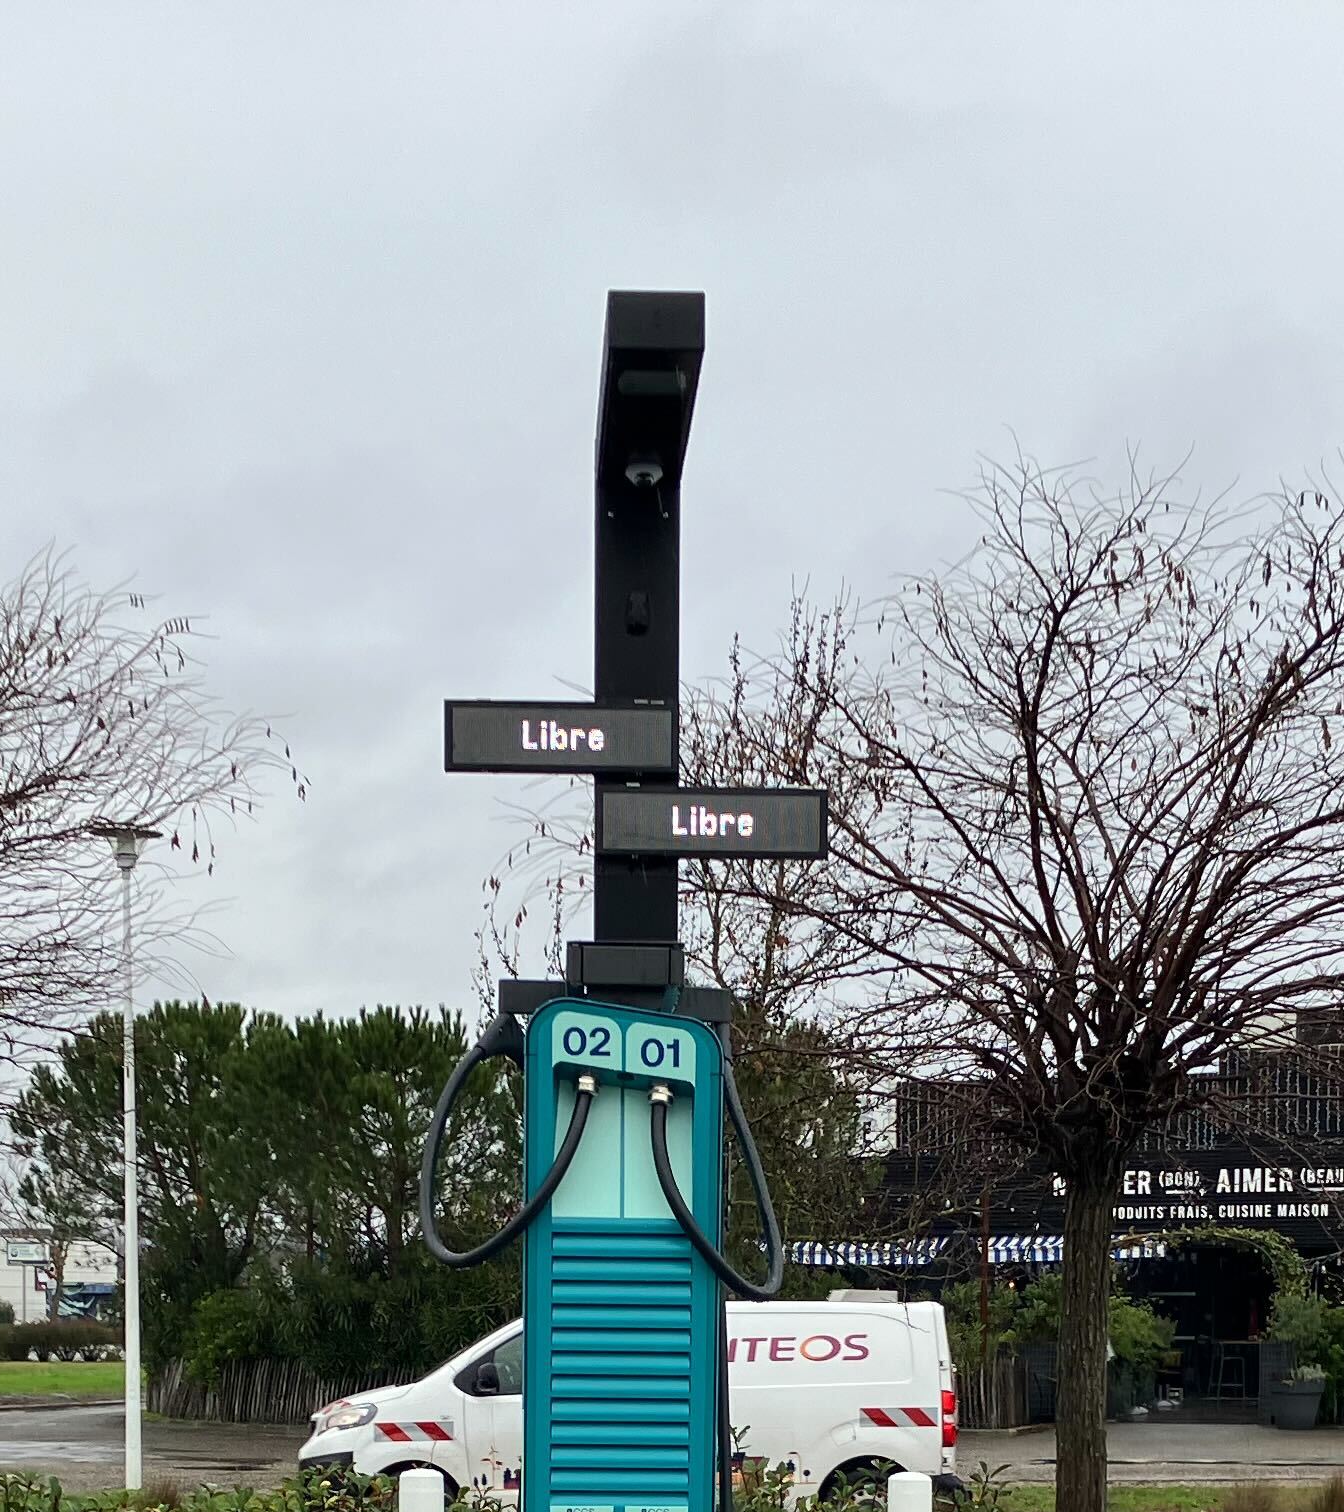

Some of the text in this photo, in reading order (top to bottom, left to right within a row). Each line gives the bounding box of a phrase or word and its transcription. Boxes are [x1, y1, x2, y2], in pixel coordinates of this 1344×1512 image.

[522, 719, 605, 751] Libre
[671, 805, 754, 837] Libre
[563, 1027, 611, 1056] 02
[640, 1038, 680, 1068] 01
[1216, 1167, 1294, 1193] AIMER
[1218, 1205, 1272, 1218] CUISINE
[1277, 1204, 1329, 1217] MAISON
[728, 1334, 869, 1363] ITEOS
